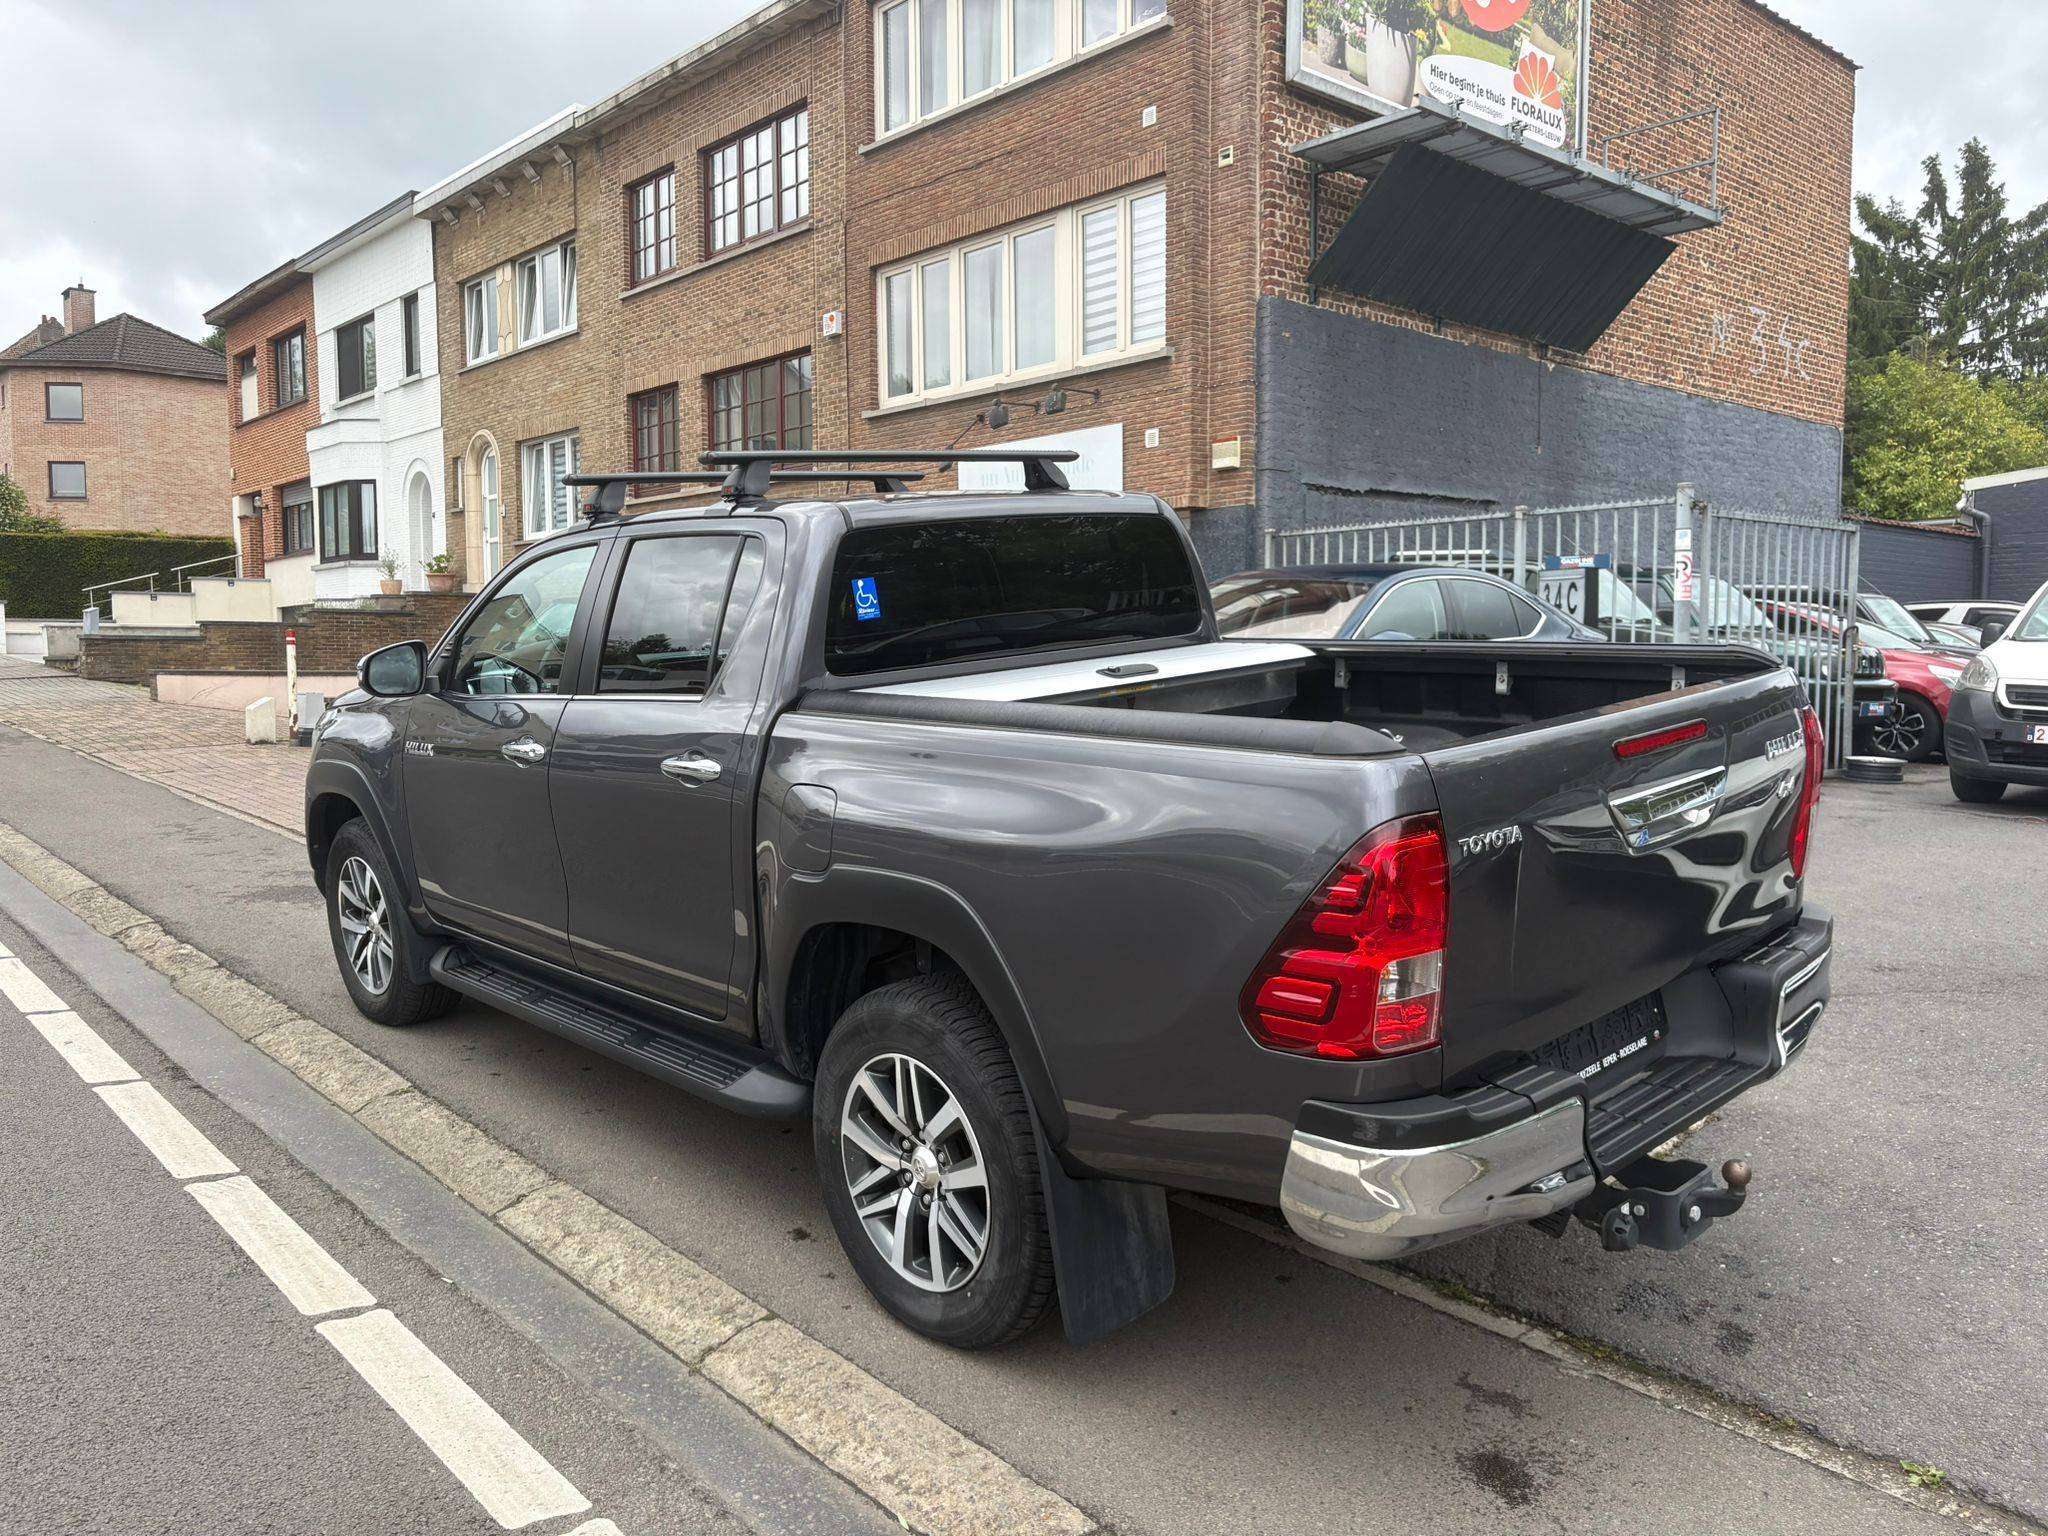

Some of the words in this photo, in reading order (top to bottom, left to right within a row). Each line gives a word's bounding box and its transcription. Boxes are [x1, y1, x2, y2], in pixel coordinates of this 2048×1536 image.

[1430, 63, 1447, 81] Hier
[1449, 72, 1475, 93] begint
[1476, 84, 1484, 97] je
[1486, 88, 1505, 106] thuis
[1511, 96, 1562, 131] FLORALUX
[1458, 825, 1522, 857] TOYOTA
